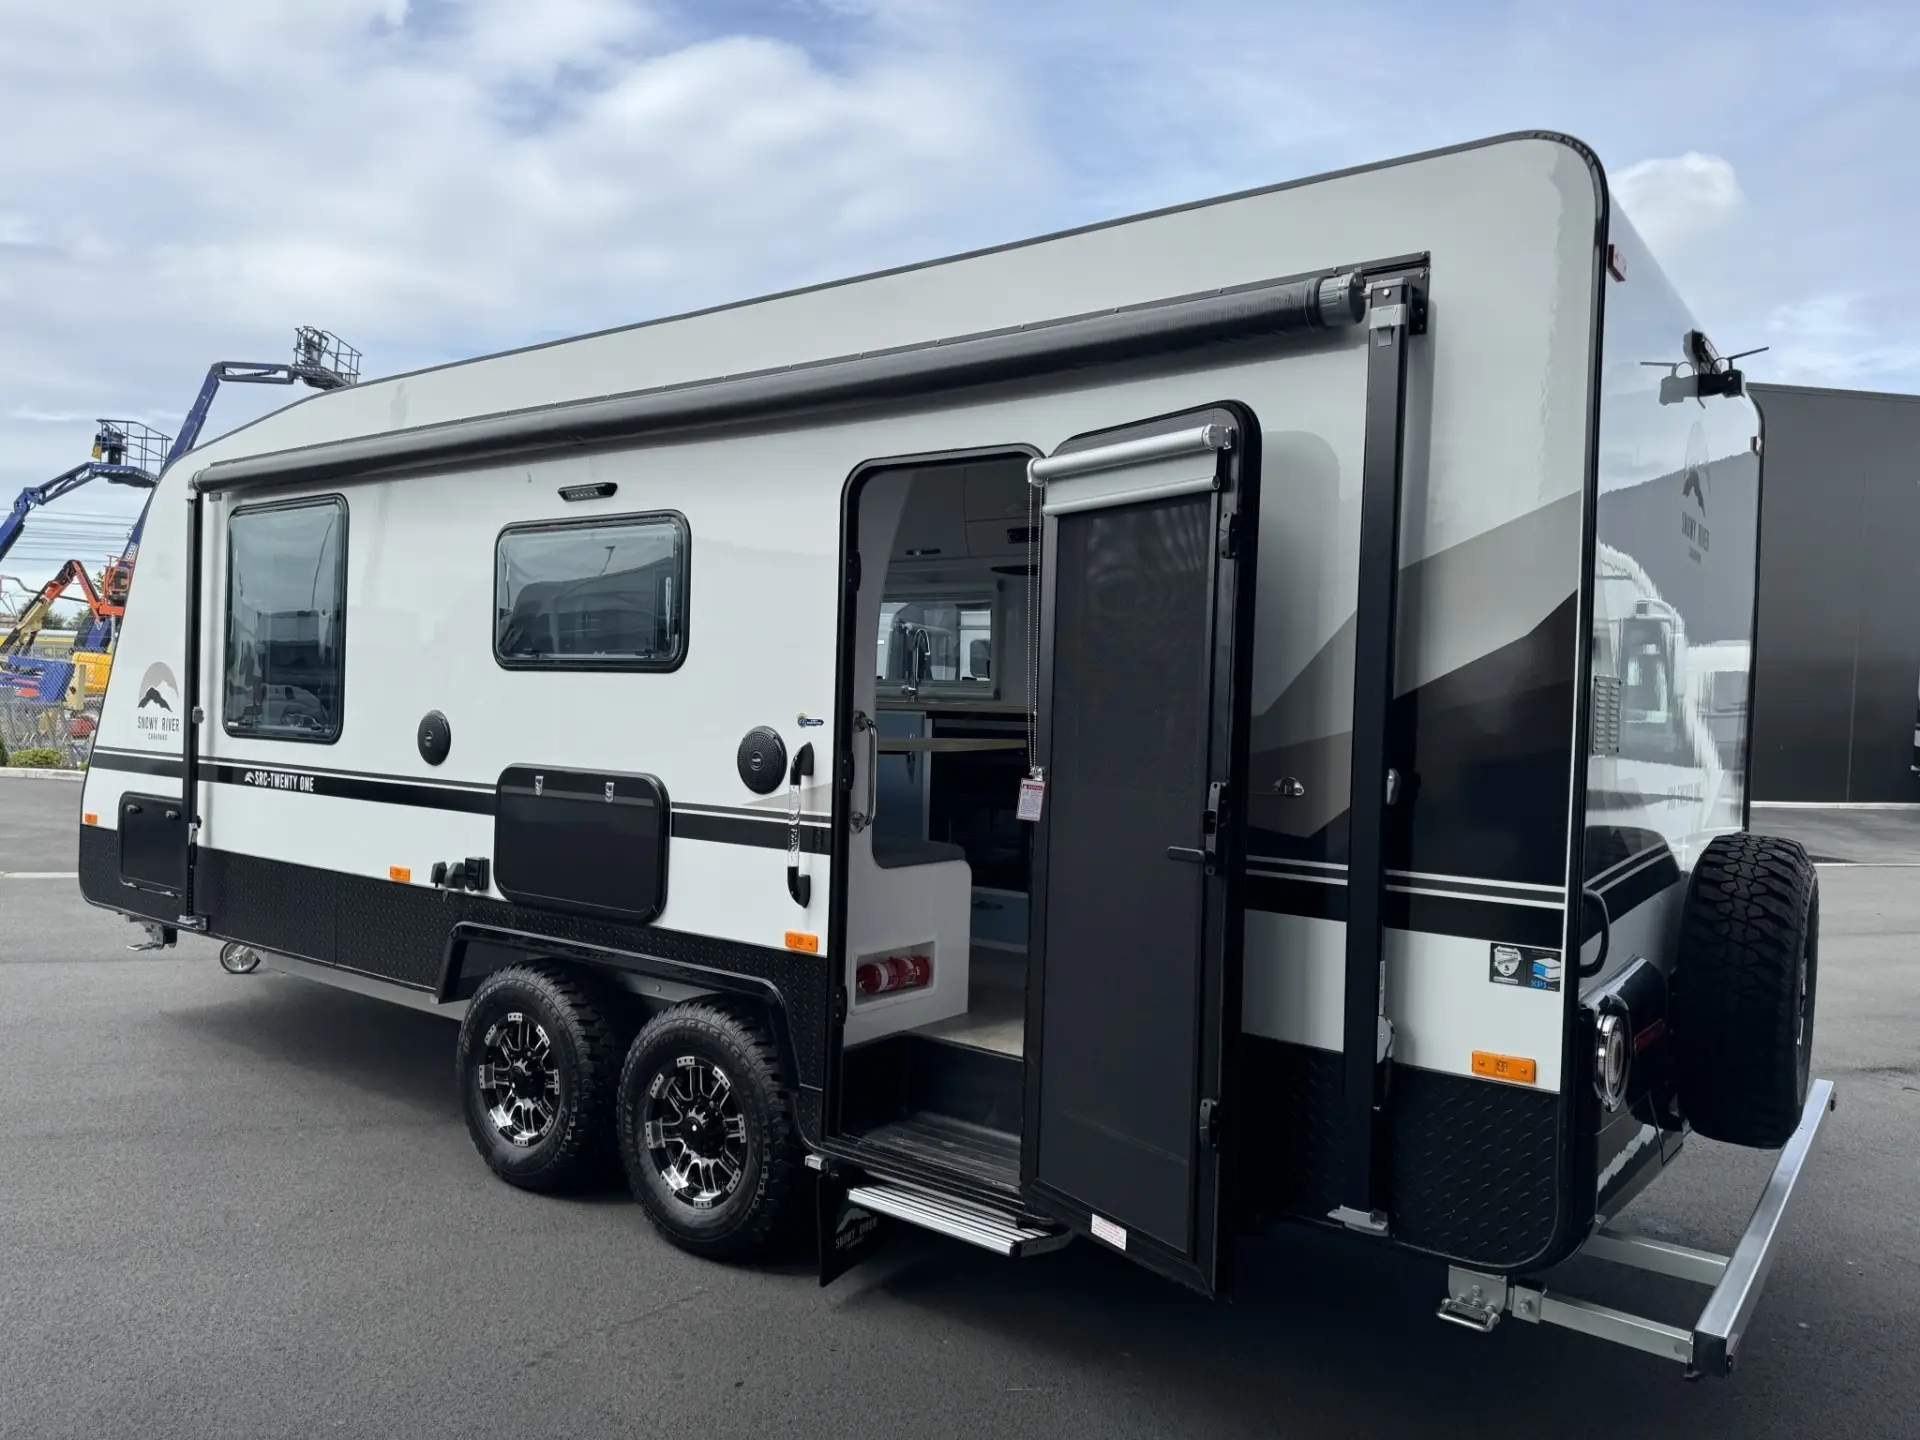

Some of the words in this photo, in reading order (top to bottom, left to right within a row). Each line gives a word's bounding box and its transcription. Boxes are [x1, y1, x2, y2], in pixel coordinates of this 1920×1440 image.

[137, 715, 159, 730] SNOWY
[161, 717, 180, 732] RIVER
[254, 770, 298, 790] SRC-TWENTY
[299, 775, 315, 792] ONE
[1531, 979, 1548, 989] XPS
